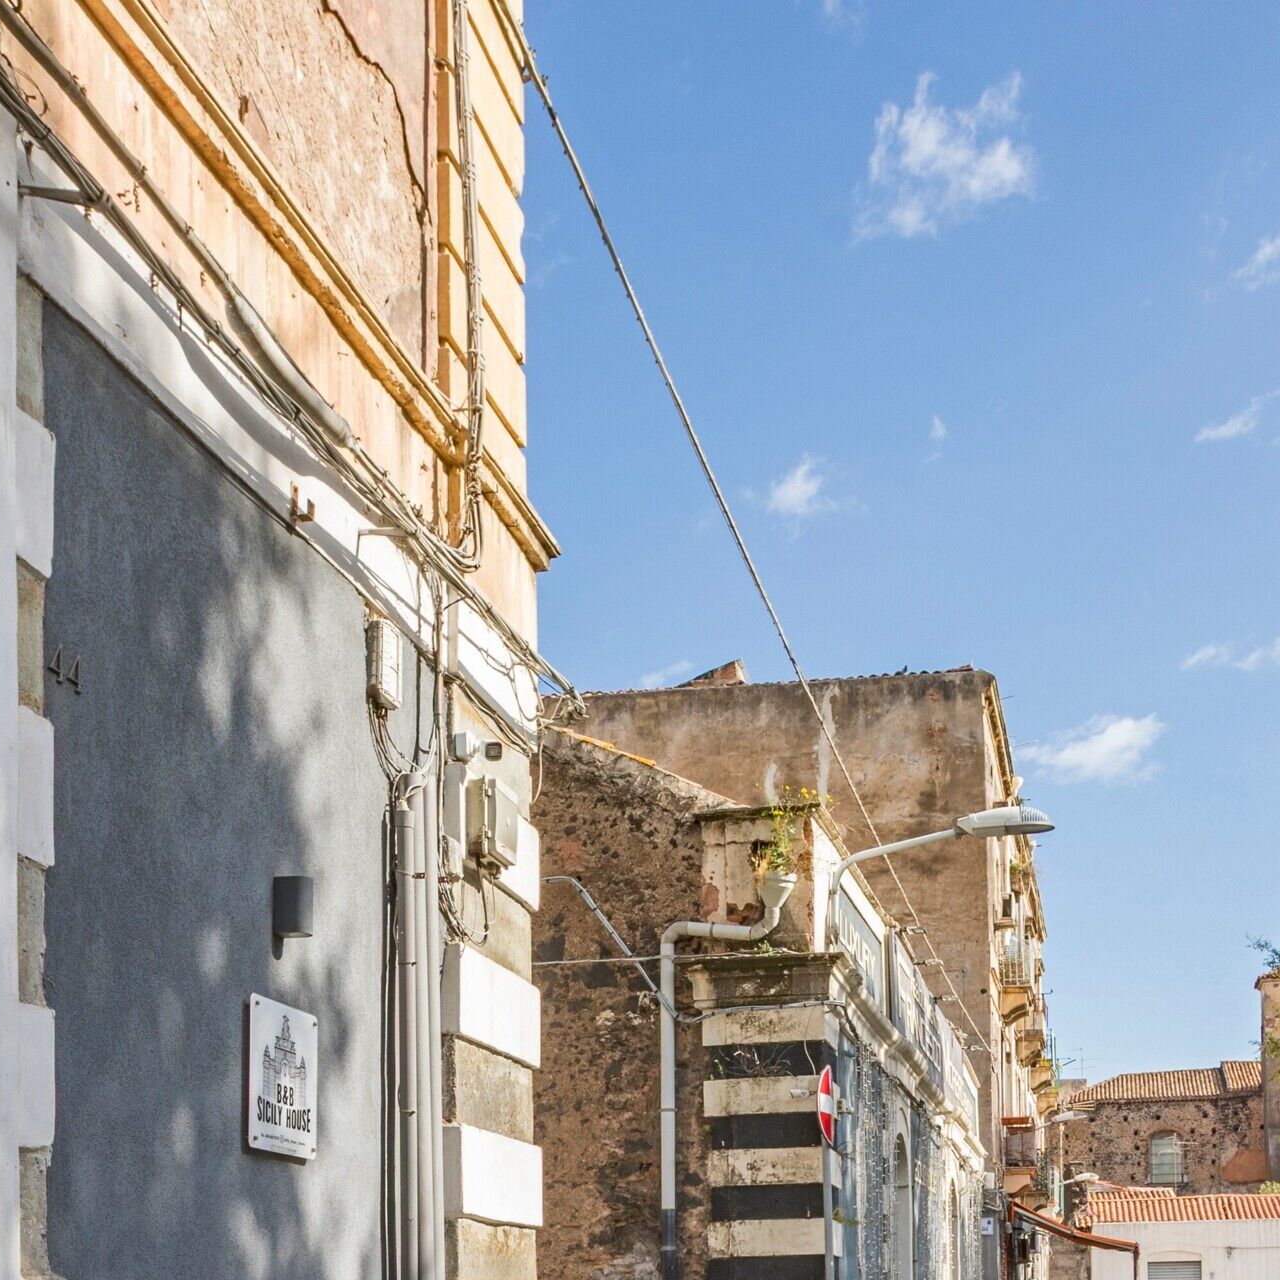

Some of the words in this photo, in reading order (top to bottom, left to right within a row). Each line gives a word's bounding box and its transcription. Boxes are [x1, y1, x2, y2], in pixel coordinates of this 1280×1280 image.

[48, 644, 81, 694] 44
[840, 908, 876, 980] LUXURY
[257, 1095, 282, 1126] SICILY
[286, 1108, 311, 1133] HOUSE
[277, 1083, 294, 1106] B&B
